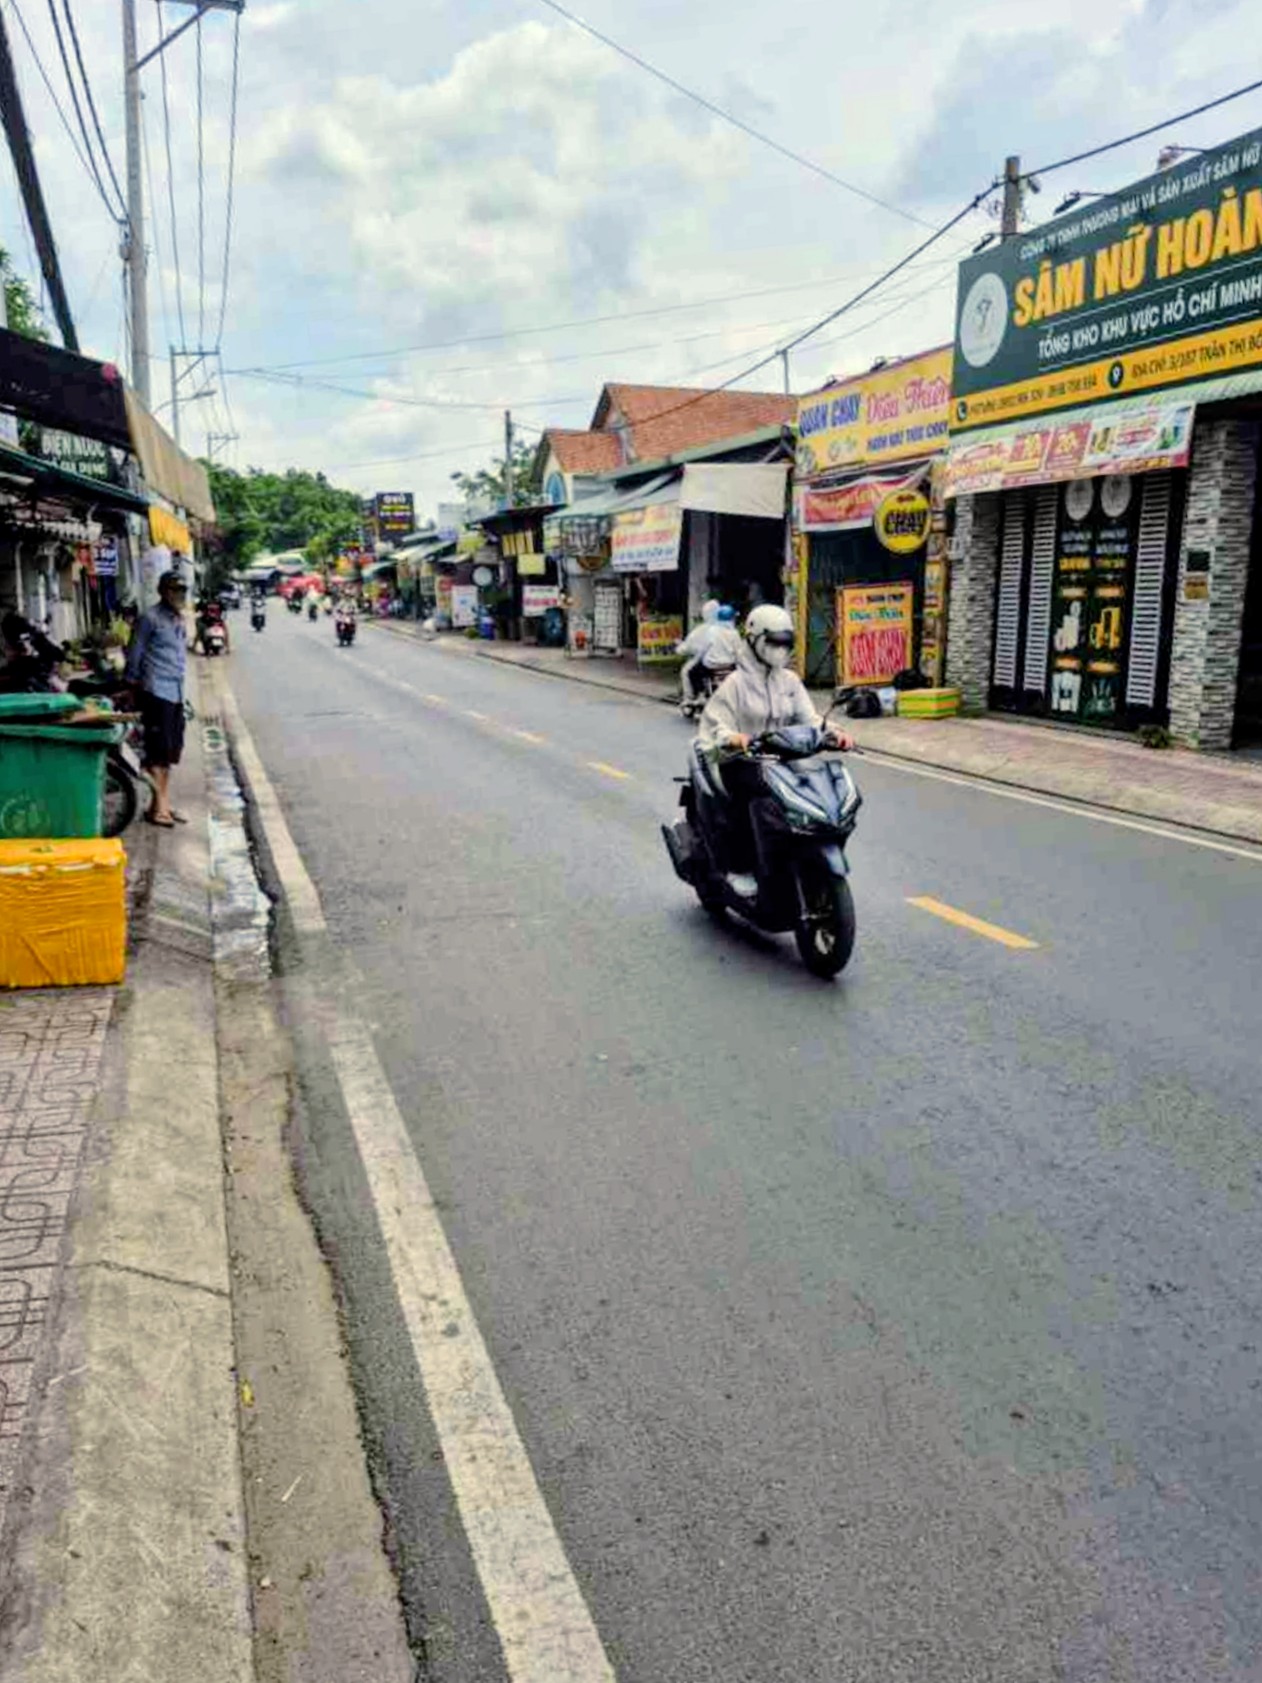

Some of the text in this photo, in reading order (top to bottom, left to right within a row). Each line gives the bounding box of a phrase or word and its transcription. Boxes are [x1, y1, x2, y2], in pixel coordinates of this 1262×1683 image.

[1013, 256, 1086, 328] SÂM
[1093, 221, 1154, 300] NỮ
[1038, 273, 1262, 359] TỔNG KHO KHU VỰC HỒ CHÍ MINH
